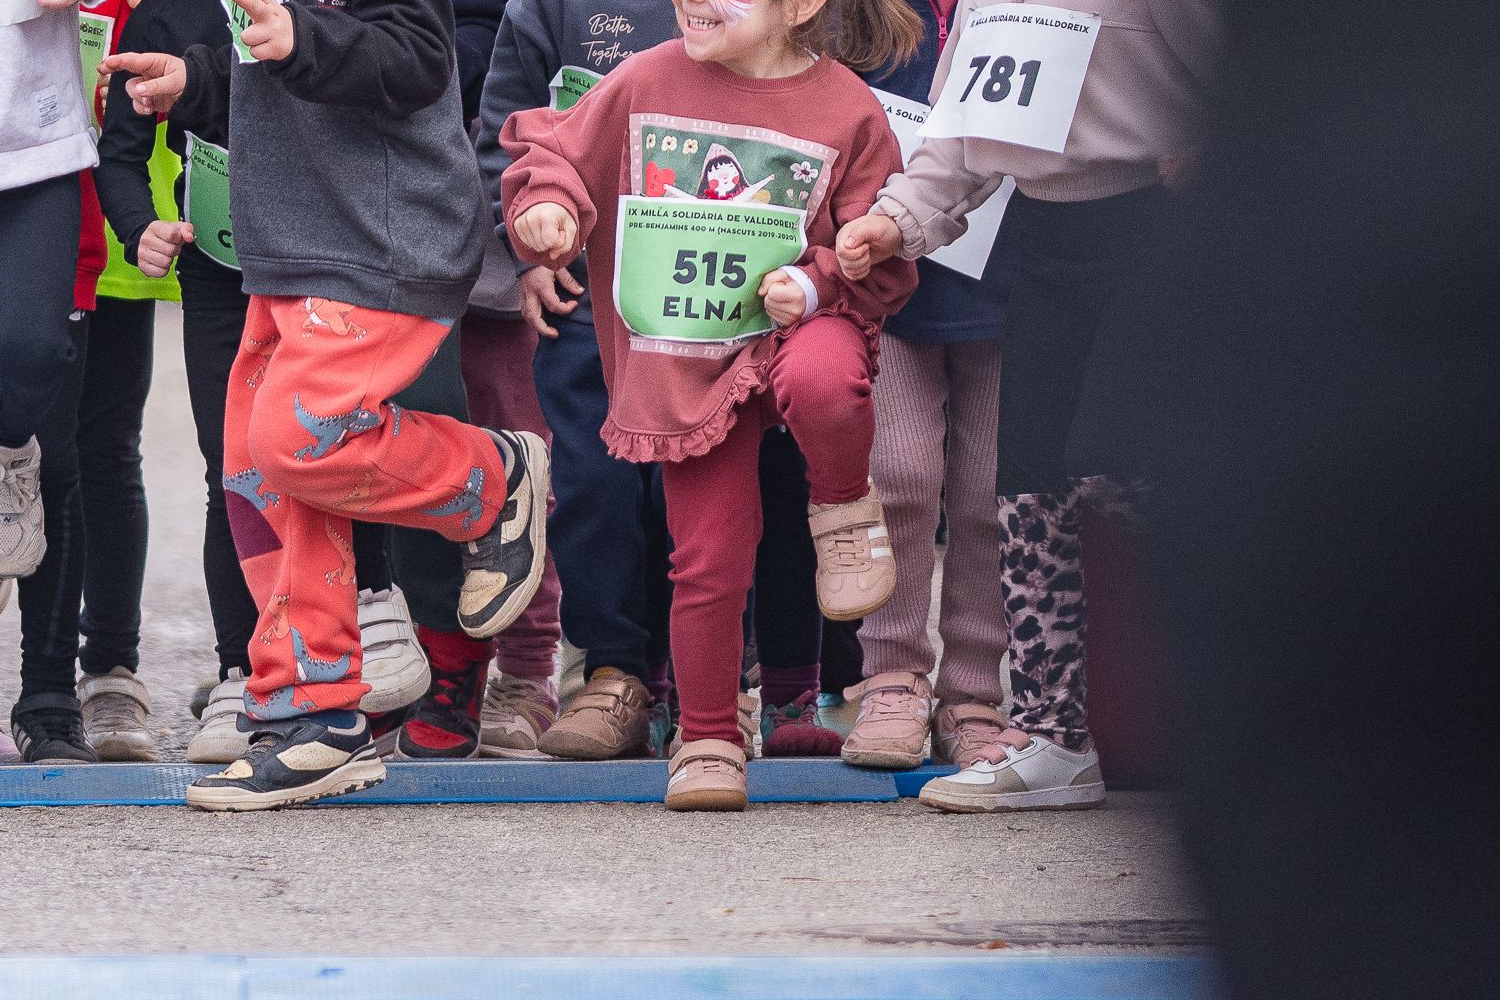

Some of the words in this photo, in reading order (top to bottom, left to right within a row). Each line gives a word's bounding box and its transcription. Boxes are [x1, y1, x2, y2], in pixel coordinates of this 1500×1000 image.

[588, 13, 635, 37] Better
[1021, 15, 1033, 24] DE
[1035, 16, 1090, 34] VALLDOREIX
[580, 40, 634, 66] Together
[959, 55, 1042, 107] 781
[895, 108, 925, 125] SOLID
[628, 208, 638, 216] IX
[640, 208, 669, 218] MILLA
[672, 210, 723, 221] SOLIDÀRIA
[726, 214, 740, 222] DE
[629, 221, 688, 231] PRE-BENJAMINS
[717, 227, 756, 237] (NASCUTS
[757, 230, 797, 242] 2019-2020)
[672, 249, 747, 289] 515
[662, 295, 742, 322] ELNA
